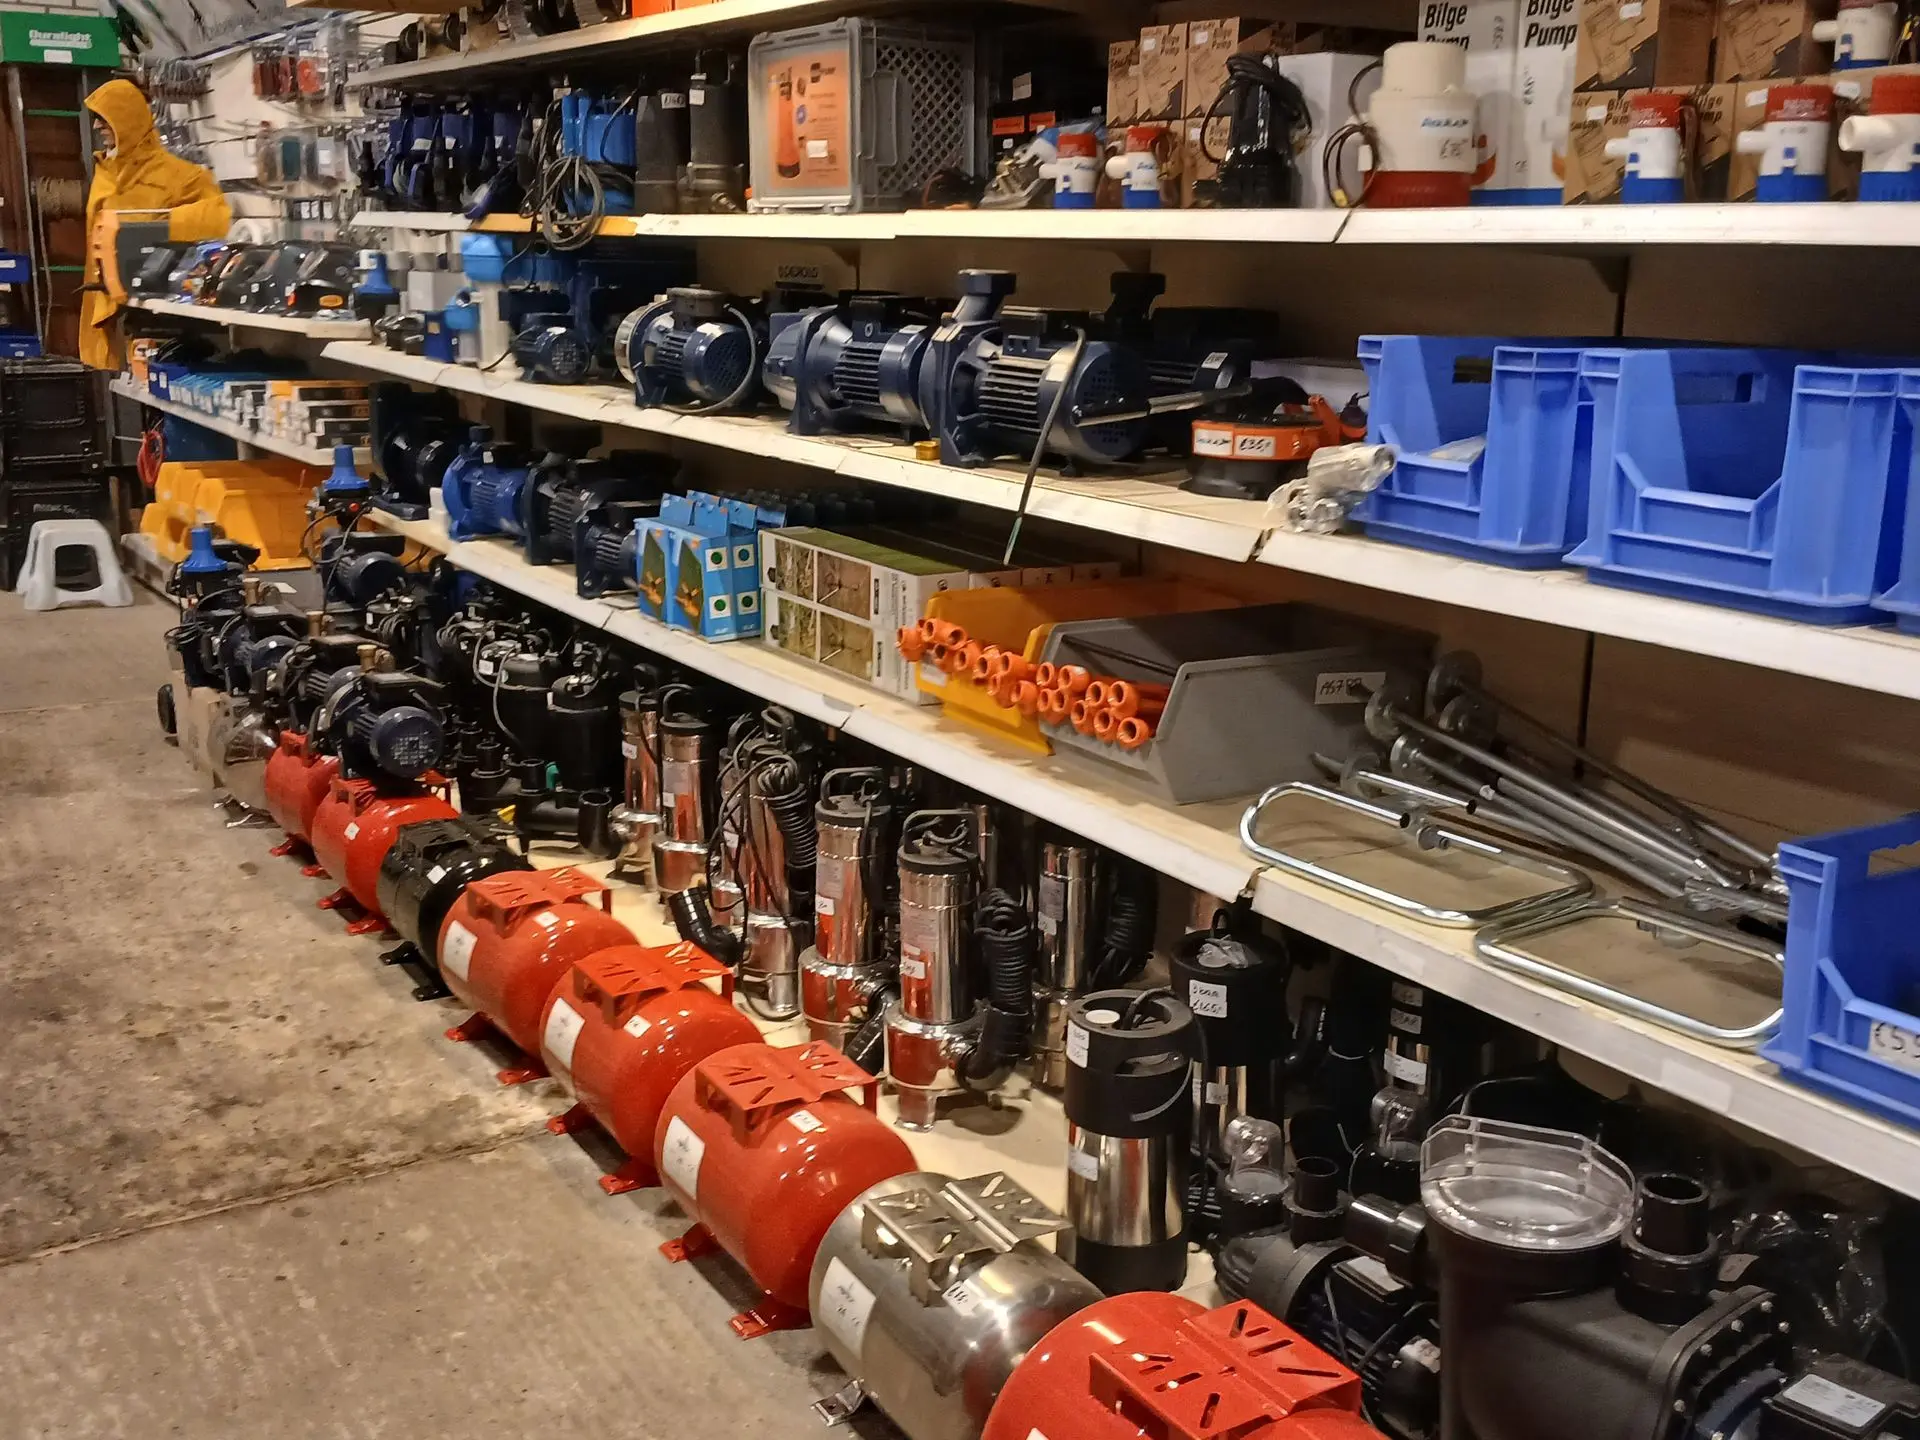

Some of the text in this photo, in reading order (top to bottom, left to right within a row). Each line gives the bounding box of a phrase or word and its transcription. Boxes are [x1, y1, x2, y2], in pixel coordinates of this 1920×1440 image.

[1424, 4, 1468, 31] Bilge
[1526, 0, 1574, 20] Bilge
[1524, 22, 1578, 51] Pump
[1606, 98, 1630, 112] Bilg
[1604, 112, 1630, 126] Pum
